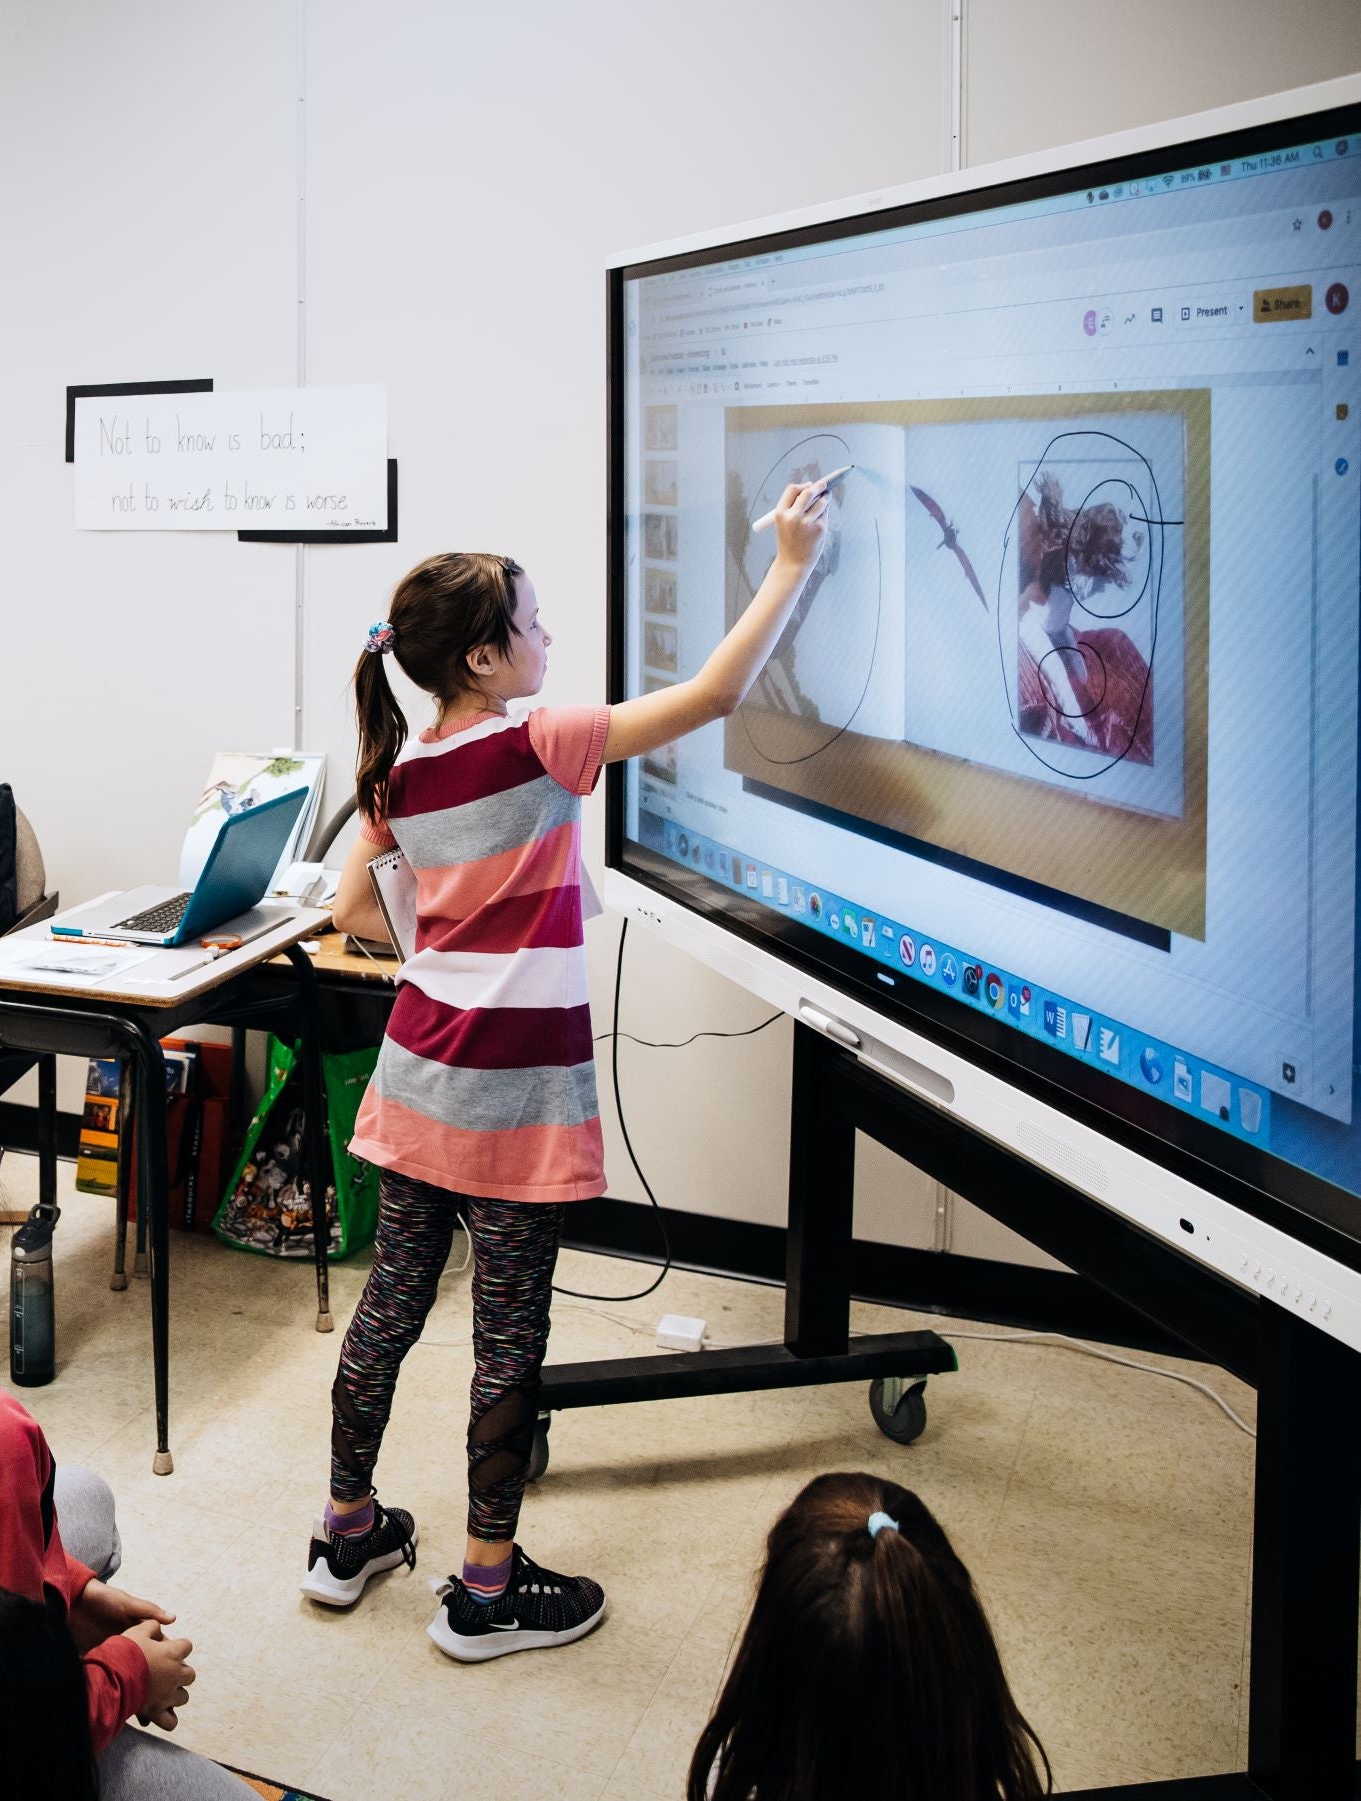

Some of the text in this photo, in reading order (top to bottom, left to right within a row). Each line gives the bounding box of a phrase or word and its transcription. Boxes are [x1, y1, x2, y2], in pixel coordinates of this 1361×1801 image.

[1241, 160, 1257, 173] Thu
[1260, 155, 1282, 167] 11:36
[1284, 152, 1300, 165] AM
[1196, 306, 1228, 318] Present
[1274, 298, 1301, 311] Share
[100, 412, 305, 456] Not to know is bad;
[112, 480, 349, 512] not to wish to know is worse
